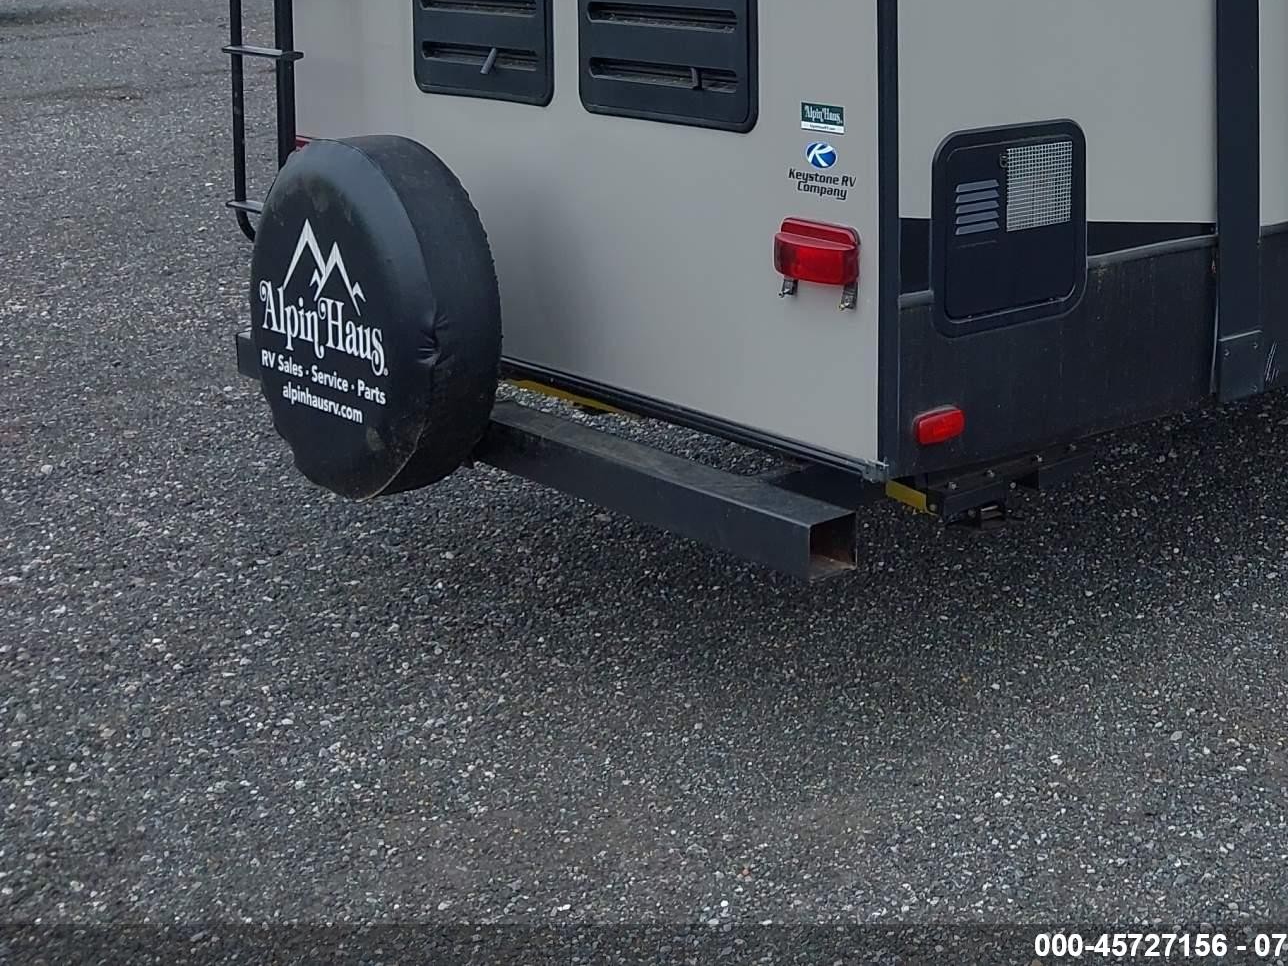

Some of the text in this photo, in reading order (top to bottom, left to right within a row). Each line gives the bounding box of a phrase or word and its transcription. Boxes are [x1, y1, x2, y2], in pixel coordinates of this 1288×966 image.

[788, 168, 857, 187] Keystone RV
[797, 180, 848, 201] Company
[259, 280, 386, 376] Alpin Haus
[261, 349, 276, 368] RV
[278, 356, 303, 376] Sales
[311, 365, 348, 392] Service
[357, 379, 386, 404] Parts
[282, 382, 363, 423] alpinhausrv.com
